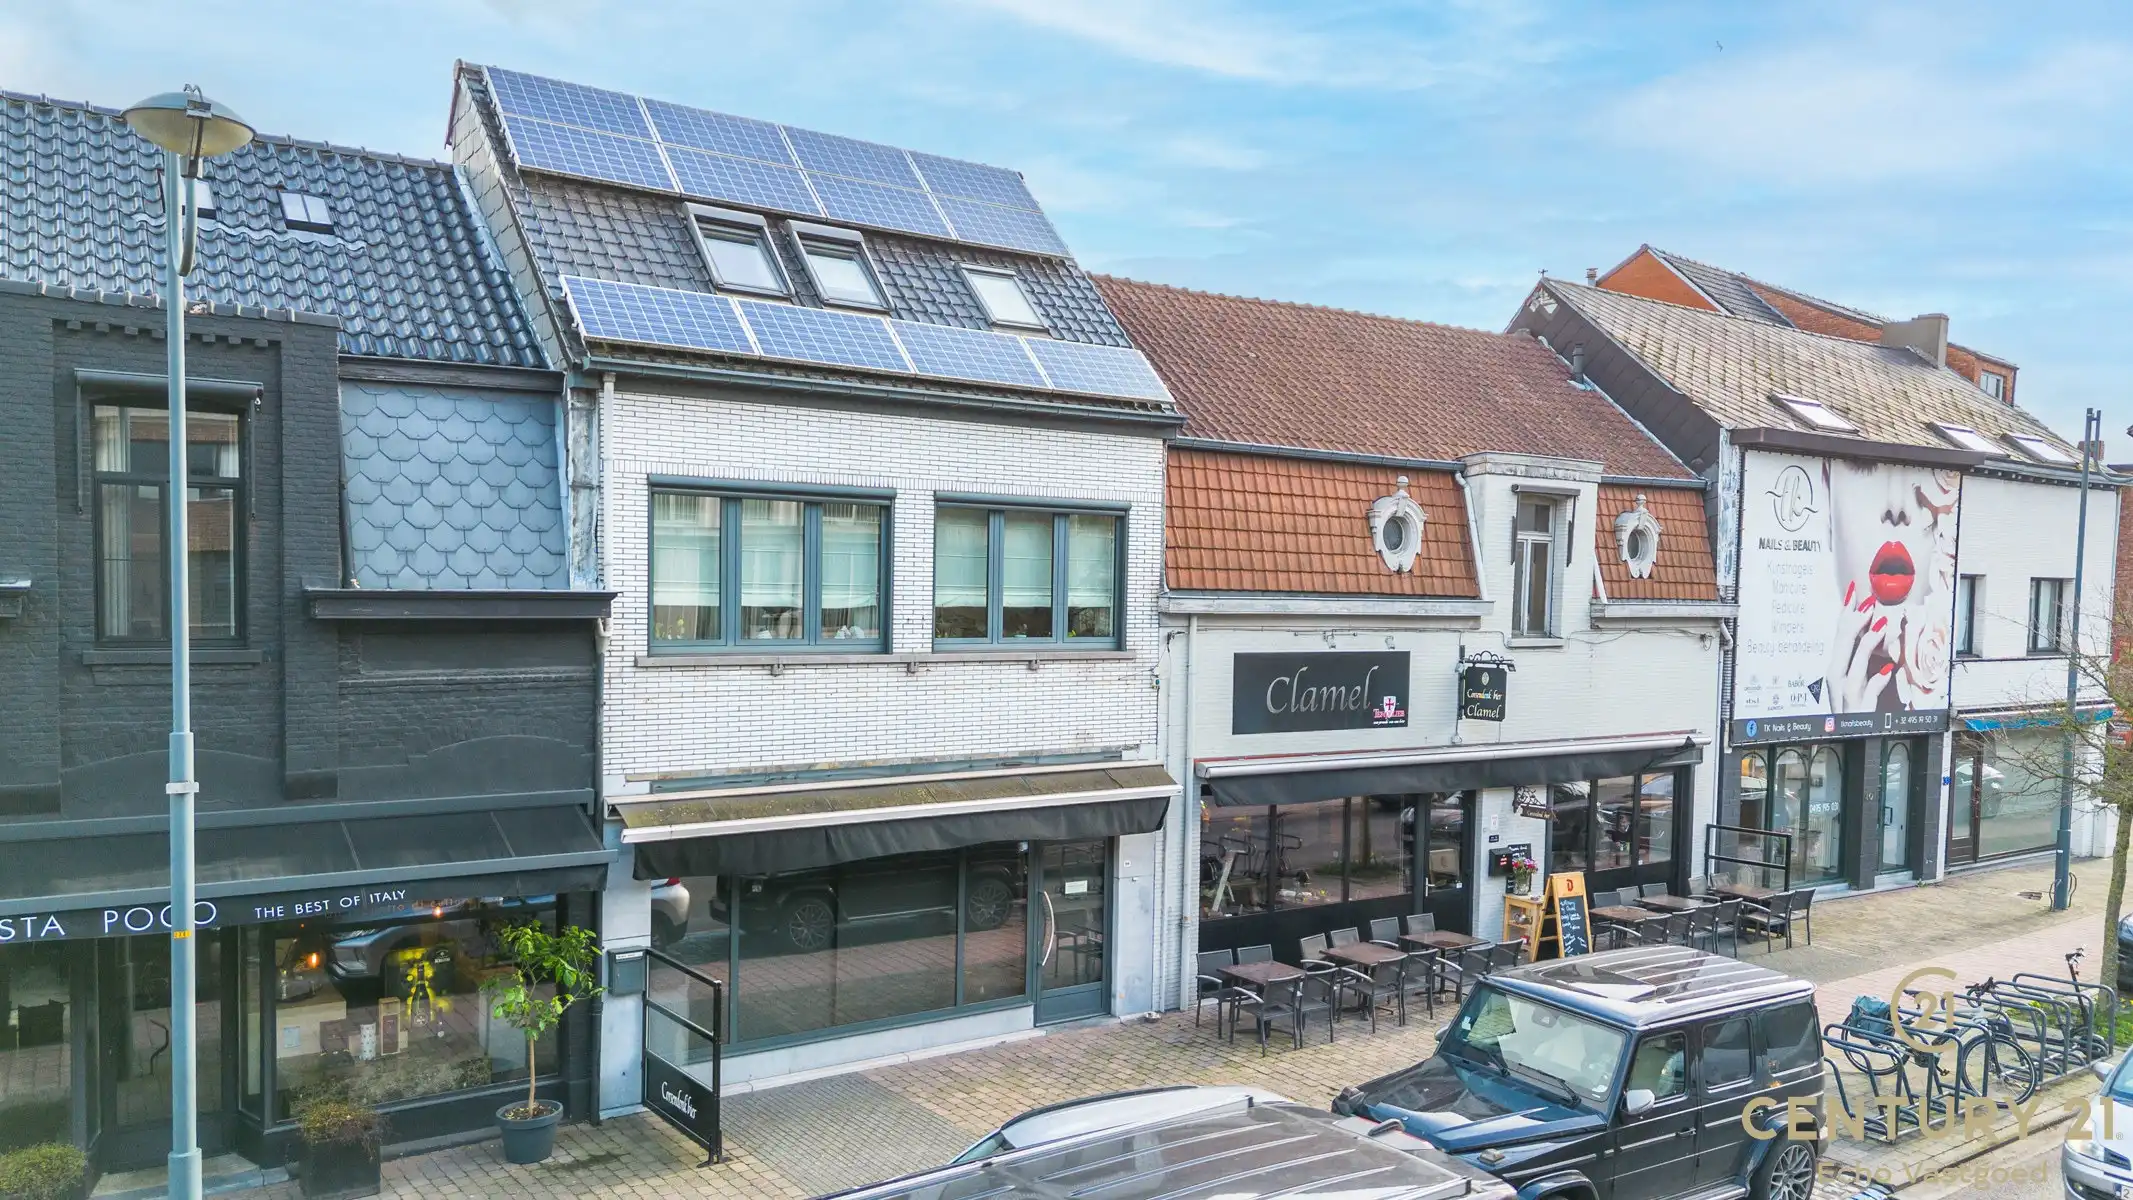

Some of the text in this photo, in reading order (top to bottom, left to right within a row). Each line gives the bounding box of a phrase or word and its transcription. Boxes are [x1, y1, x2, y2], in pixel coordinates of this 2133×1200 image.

[1758, 537, 1783, 550] NAILS
[1792, 539, 1821, 552] BEAUTY
[1772, 579, 1807, 594] Manicure
[1771, 599, 1805, 614] Pedicure
[1266, 665, 1379, 714] Clamel
[1466, 702, 1502, 718] Clamel
[1772, 722, 1785, 732] Nails
[1792, 721, 1812, 732] Beauty
[1925, 715, 1932, 723] 50
[255, 905, 285, 919] THE
[295, 899, 330, 915] BEST
[339, 895, 361, 909] OF
[369, 889, 406, 903] ITALY
[0, 914, 66, 940] STA
